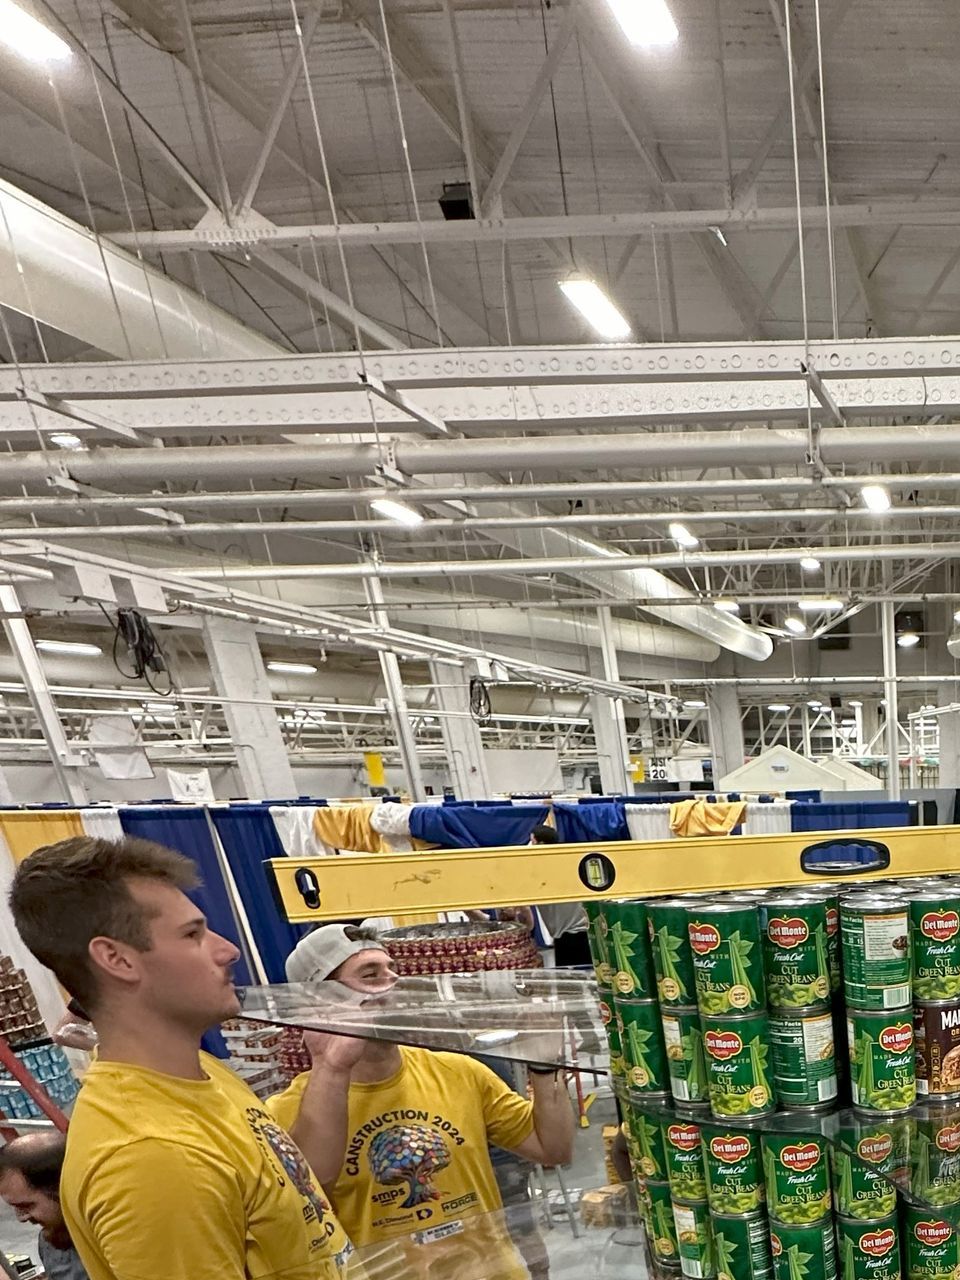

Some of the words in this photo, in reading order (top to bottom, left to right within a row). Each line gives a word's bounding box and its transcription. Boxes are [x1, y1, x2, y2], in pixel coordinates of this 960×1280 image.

[652, 769, 668, 779] 20
[923, 921, 937, 930] Del
[937, 919, 958, 929] Monte
[770, 927, 780, 935] Del
[781, 926, 806, 935] Monte
[700, 933, 717, 943] Monte
[926, 946, 942, 956] Fresh
[940, 945, 956, 953] Cut
[773, 953, 789, 962] Fresh
[789, 953, 805, 962] Cut
[935, 958, 951, 968] CUT
[781, 966, 799, 975] CUT
[918, 967, 943, 977] GREEN
[769, 975, 792, 984] GREEN
[792, 974, 816, 983] BEANS
[706, 982, 731, 991] BEANS
[718, 1038, 740, 1049] Monte
[882, 1034, 896, 1045] Del
[710, 1063, 725, 1073] Fresh
[725, 1064, 737, 1073] Cut
[886, 1058, 900, 1068] Fresh
[894, 1069, 908, 1079] CUT
[717, 1076, 732, 1085] CUT
[878, 1078, 901, 1089] GREEN
[726, 1085, 751, 1094] BEANS
[670, 1132, 682, 1140] Del
[346, 1109, 429, 1176] CANSTRUCTION
[432, 1116, 465, 1146] 2024
[713, 1144, 725, 1152] Del
[725, 1143, 748, 1151] Monte
[783, 1152, 795, 1160] Del
[796, 1150, 818, 1160] Monte
[861, 1146, 873, 1154] Del
[682, 1164, 698, 1172] CUT
[717, 1167, 733, 1175] Fresh
[732, 1166, 746, 1174] Cut
[725, 1177, 742, 1186] CUT
[787, 1175, 803, 1184] Fresh
[803, 1174, 817, 1182] Cut
[712, 1185, 735, 1194] GREEN
[796, 1186, 812, 1194] CUT
[872, 1181, 887, 1189] CUT
[372, 1187, 406, 1203] smps
[781, 1194, 805, 1203] GREEN
[805, 1190, 827, 1201] BEANS
[857, 1190, 882, 1200] GREEN
[916, 1227, 928, 1236] Del
[929, 1227, 950, 1236] Monte
[862, 1239, 874, 1247] Del
[874, 1235, 894, 1246] Monte
[918, 1248, 933, 1257] Fresh
[865, 1260, 880, 1269] Fresh
[879, 1257, 893, 1266] Cut
[926, 1259, 941, 1267] CUT
[873, 1270, 888, 1278] CUT
[912, 1265, 933, 1274] GREEN
[934, 1264, 956, 1274] BEANS
